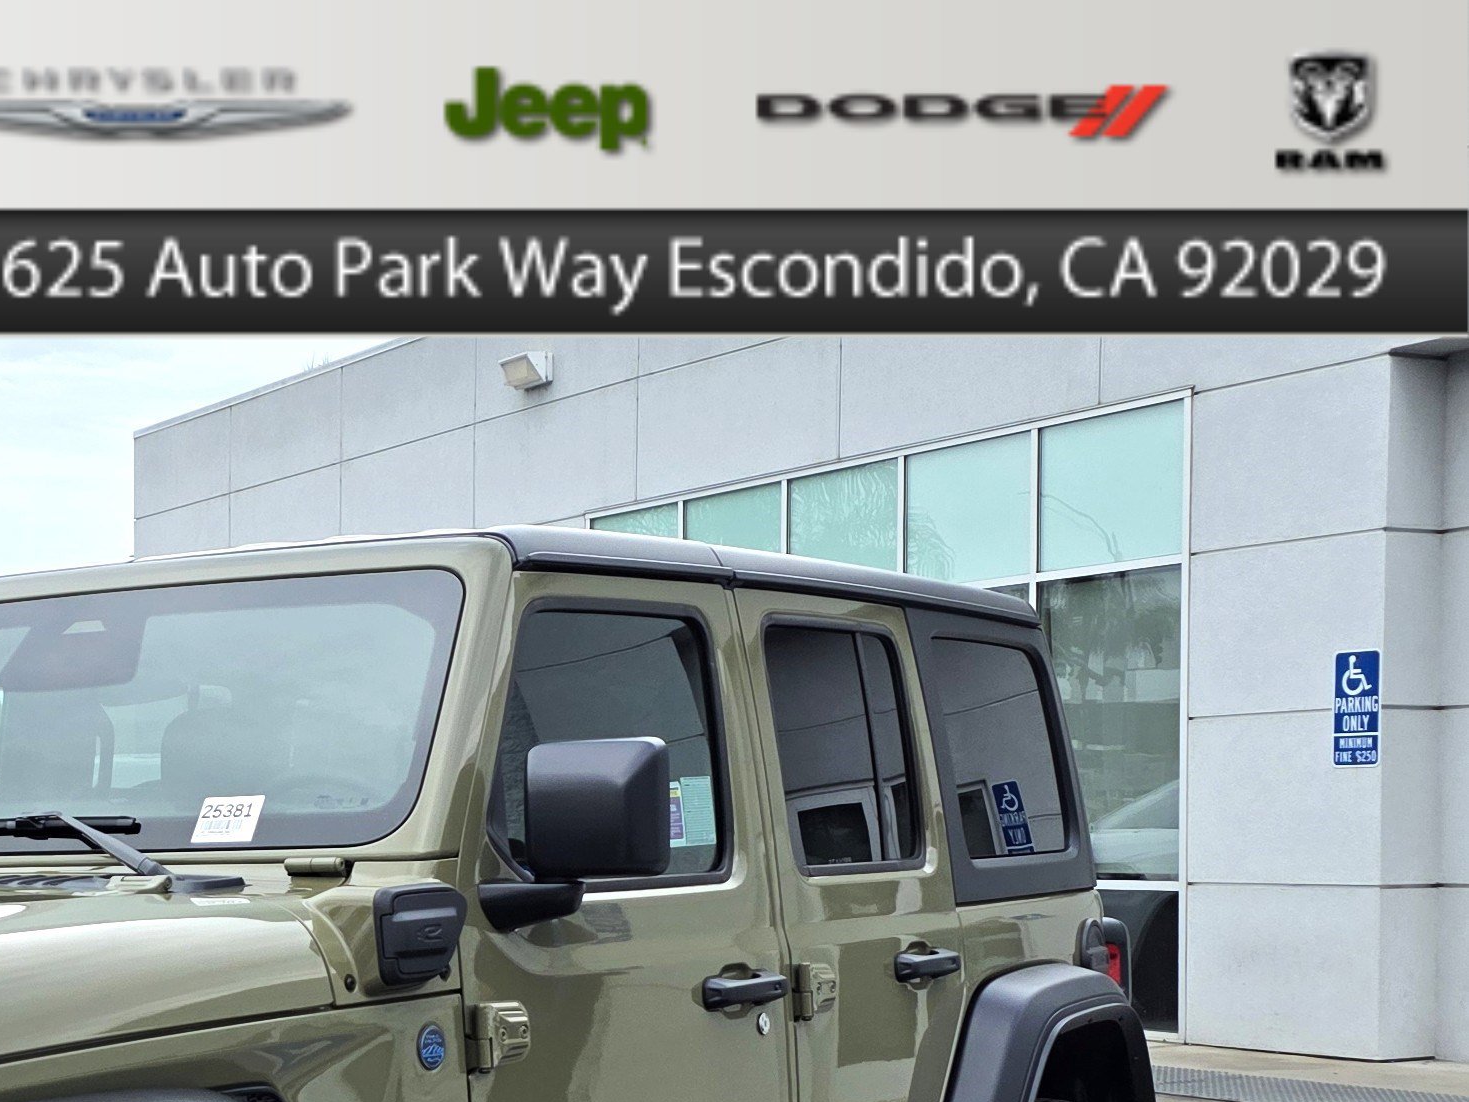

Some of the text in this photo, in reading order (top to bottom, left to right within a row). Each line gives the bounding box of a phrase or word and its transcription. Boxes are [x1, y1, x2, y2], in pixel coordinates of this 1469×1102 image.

[1334, 695, 1379, 714] PARKING
[1342, 715, 1370, 732] ONLY
[1339, 737, 1373, 749] MINIMUM
[1335, 750, 1377, 763] FINE $250
[201, 803, 253, 819] 25381
